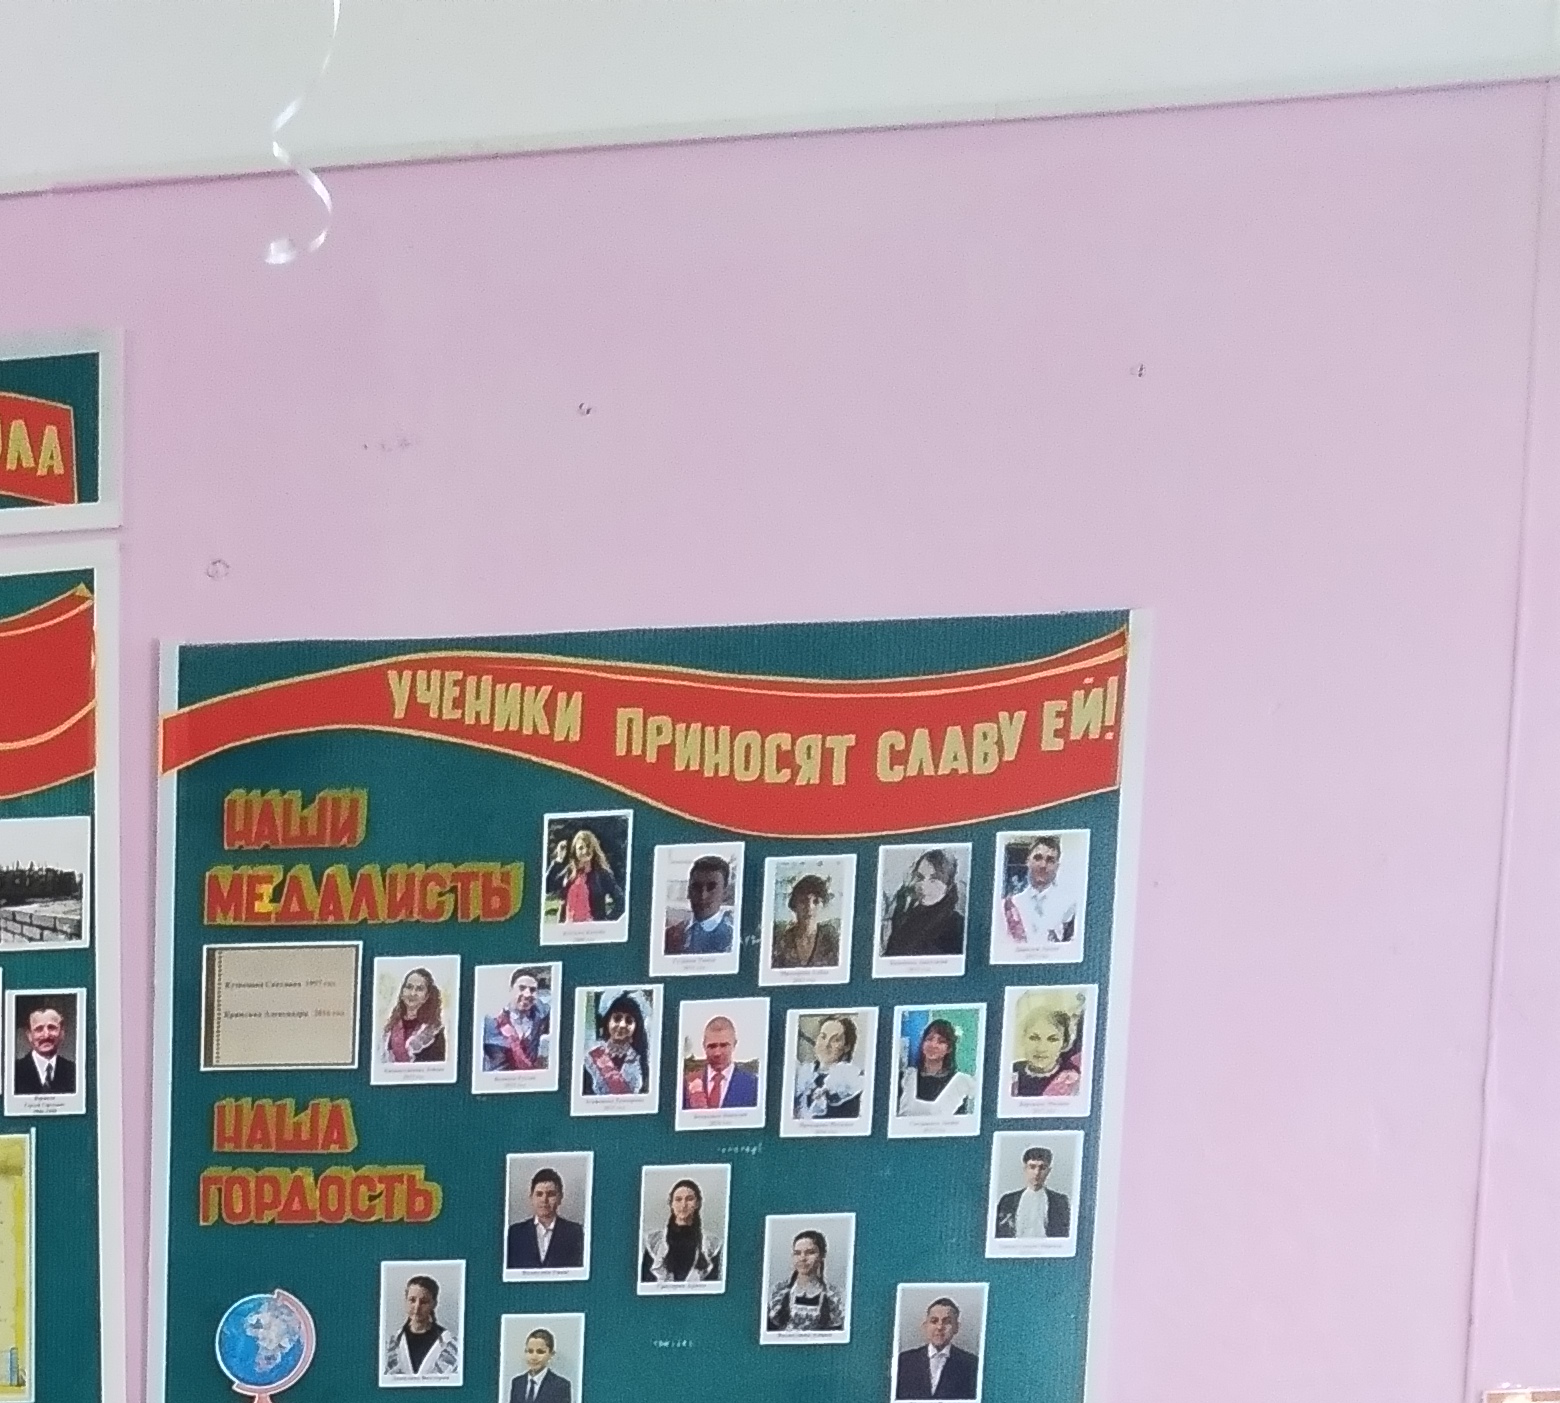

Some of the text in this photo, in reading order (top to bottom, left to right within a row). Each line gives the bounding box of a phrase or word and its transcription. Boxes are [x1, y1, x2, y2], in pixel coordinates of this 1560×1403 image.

[387, 668, 1120, 786] УЧЕНИКИ ПРИНОСЯТ СЛАВУ ЕЙ!
[224, 788, 368, 850] НАШИ
[213, 1097, 358, 1154] НАША
[199, 1164, 442, 1225] ГОРДОСТЬ
